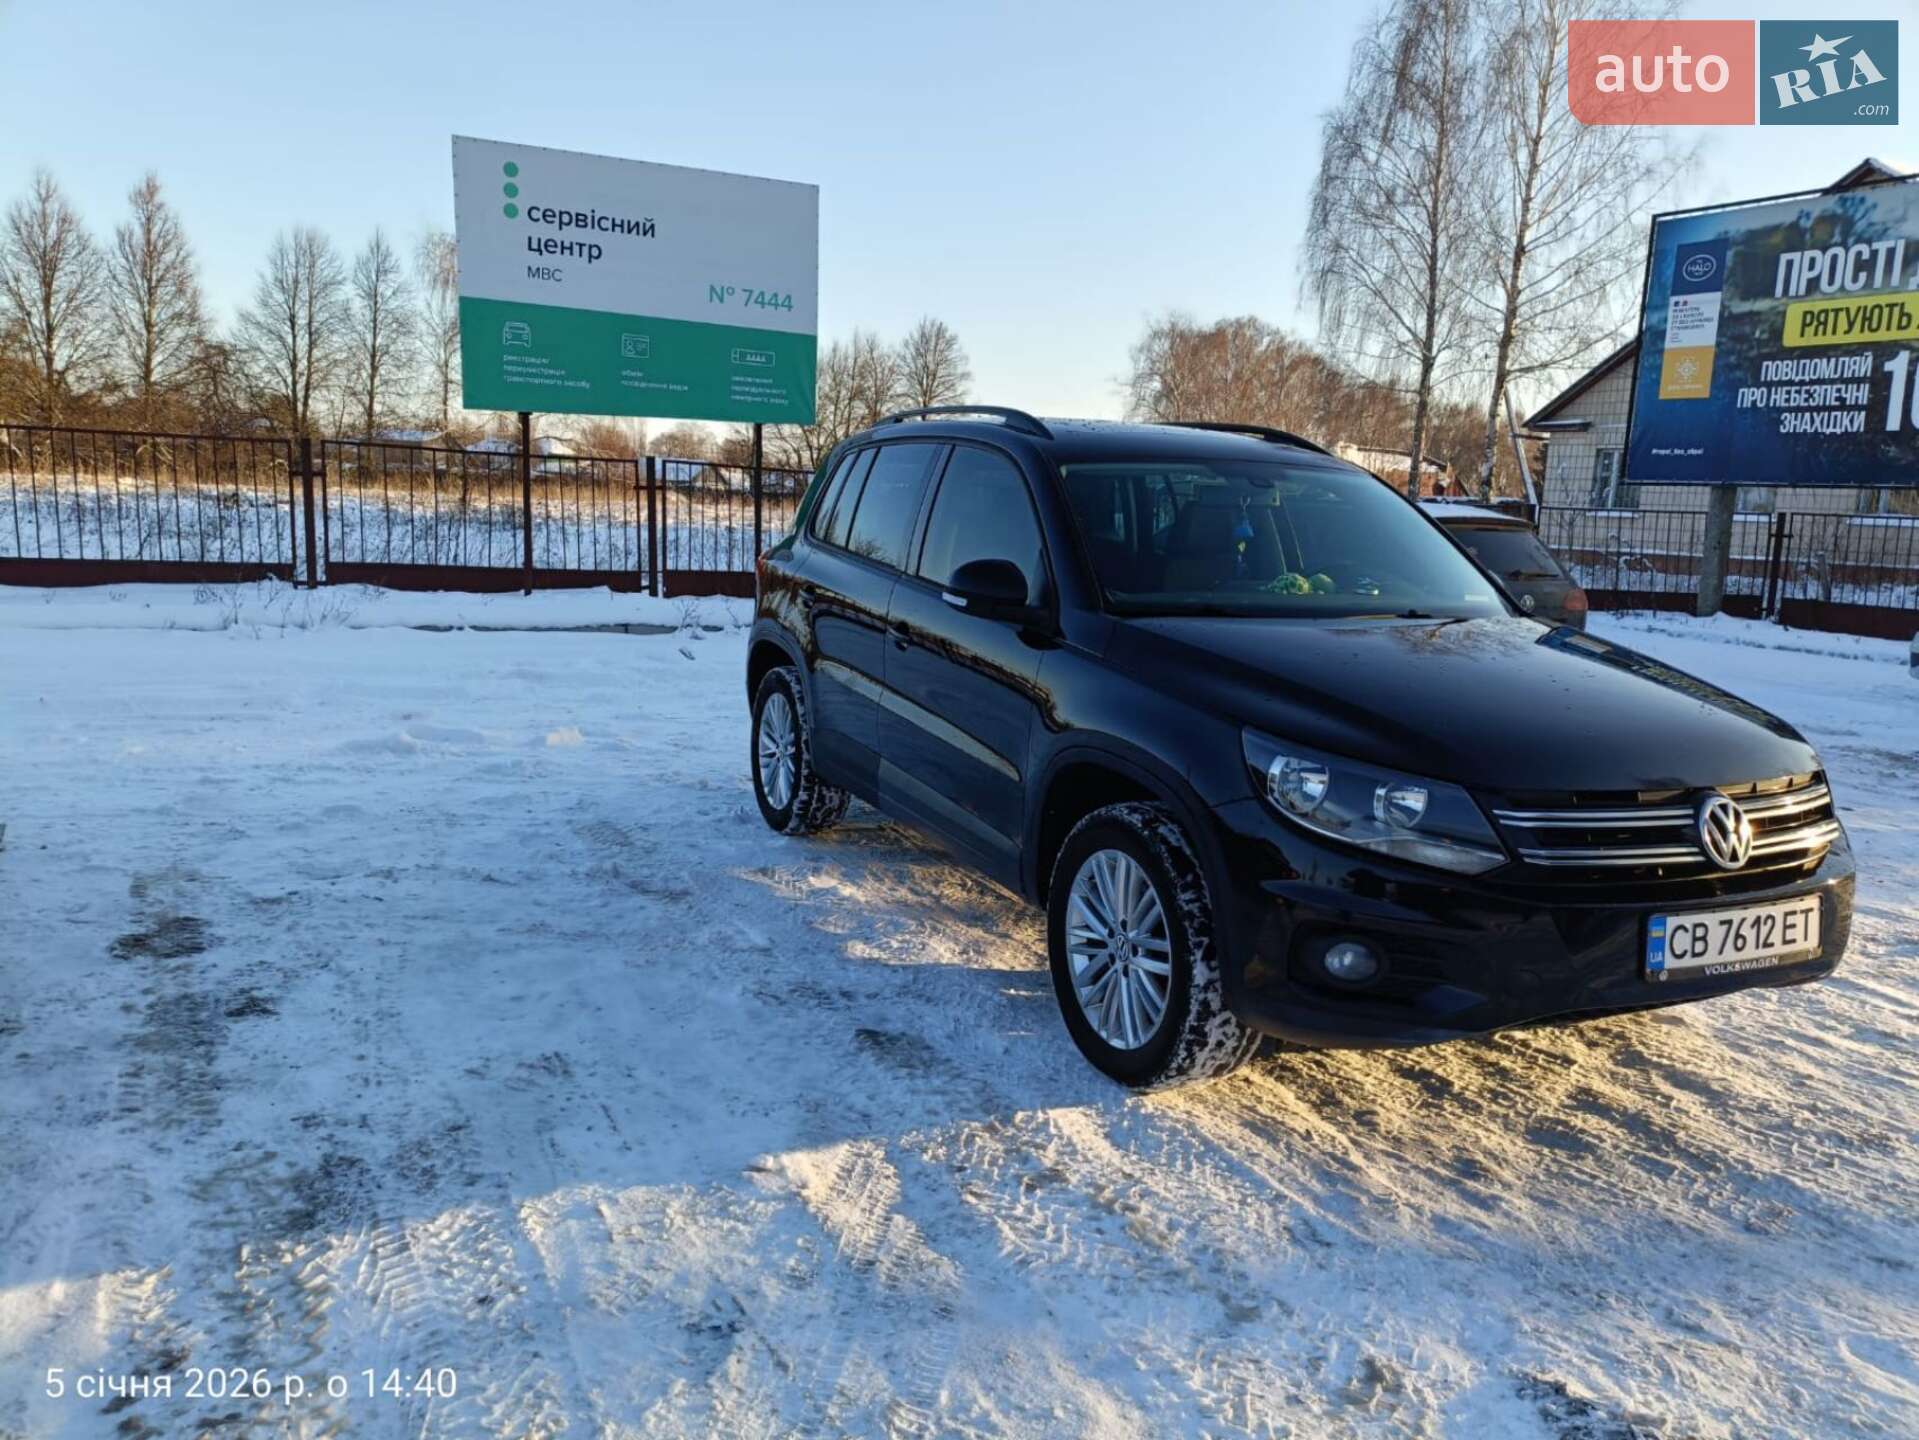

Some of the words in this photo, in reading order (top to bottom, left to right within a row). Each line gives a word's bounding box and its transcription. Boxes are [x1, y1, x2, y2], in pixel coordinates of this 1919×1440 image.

[526, 205, 656, 239] сервісний
[526, 235, 603, 264] центр
[526, 265, 563, 282] МВС
[1774, 239, 1905, 298] ПРОСТІ
[741, 288, 794, 312] 7444
[1799, 302, 1912, 338] РЯТУЮТЬ
[1760, 352, 1873, 382] ПОВІДОМЛЯЙ
[1737, 387, 1766, 408] ПРО
[1769, 383, 1870, 407] НЕБЕЗПЕЧНІ
[1780, 410, 1866, 434] ЗНАХІДКИ
[1670, 922, 1709, 959] CB
[1718, 914, 1776, 956] 7612
[1782, 908, 1814, 946] ET
[1649, 952, 1663, 963] UA
[1704, 955, 1779, 976] VOLKSWAGEN
